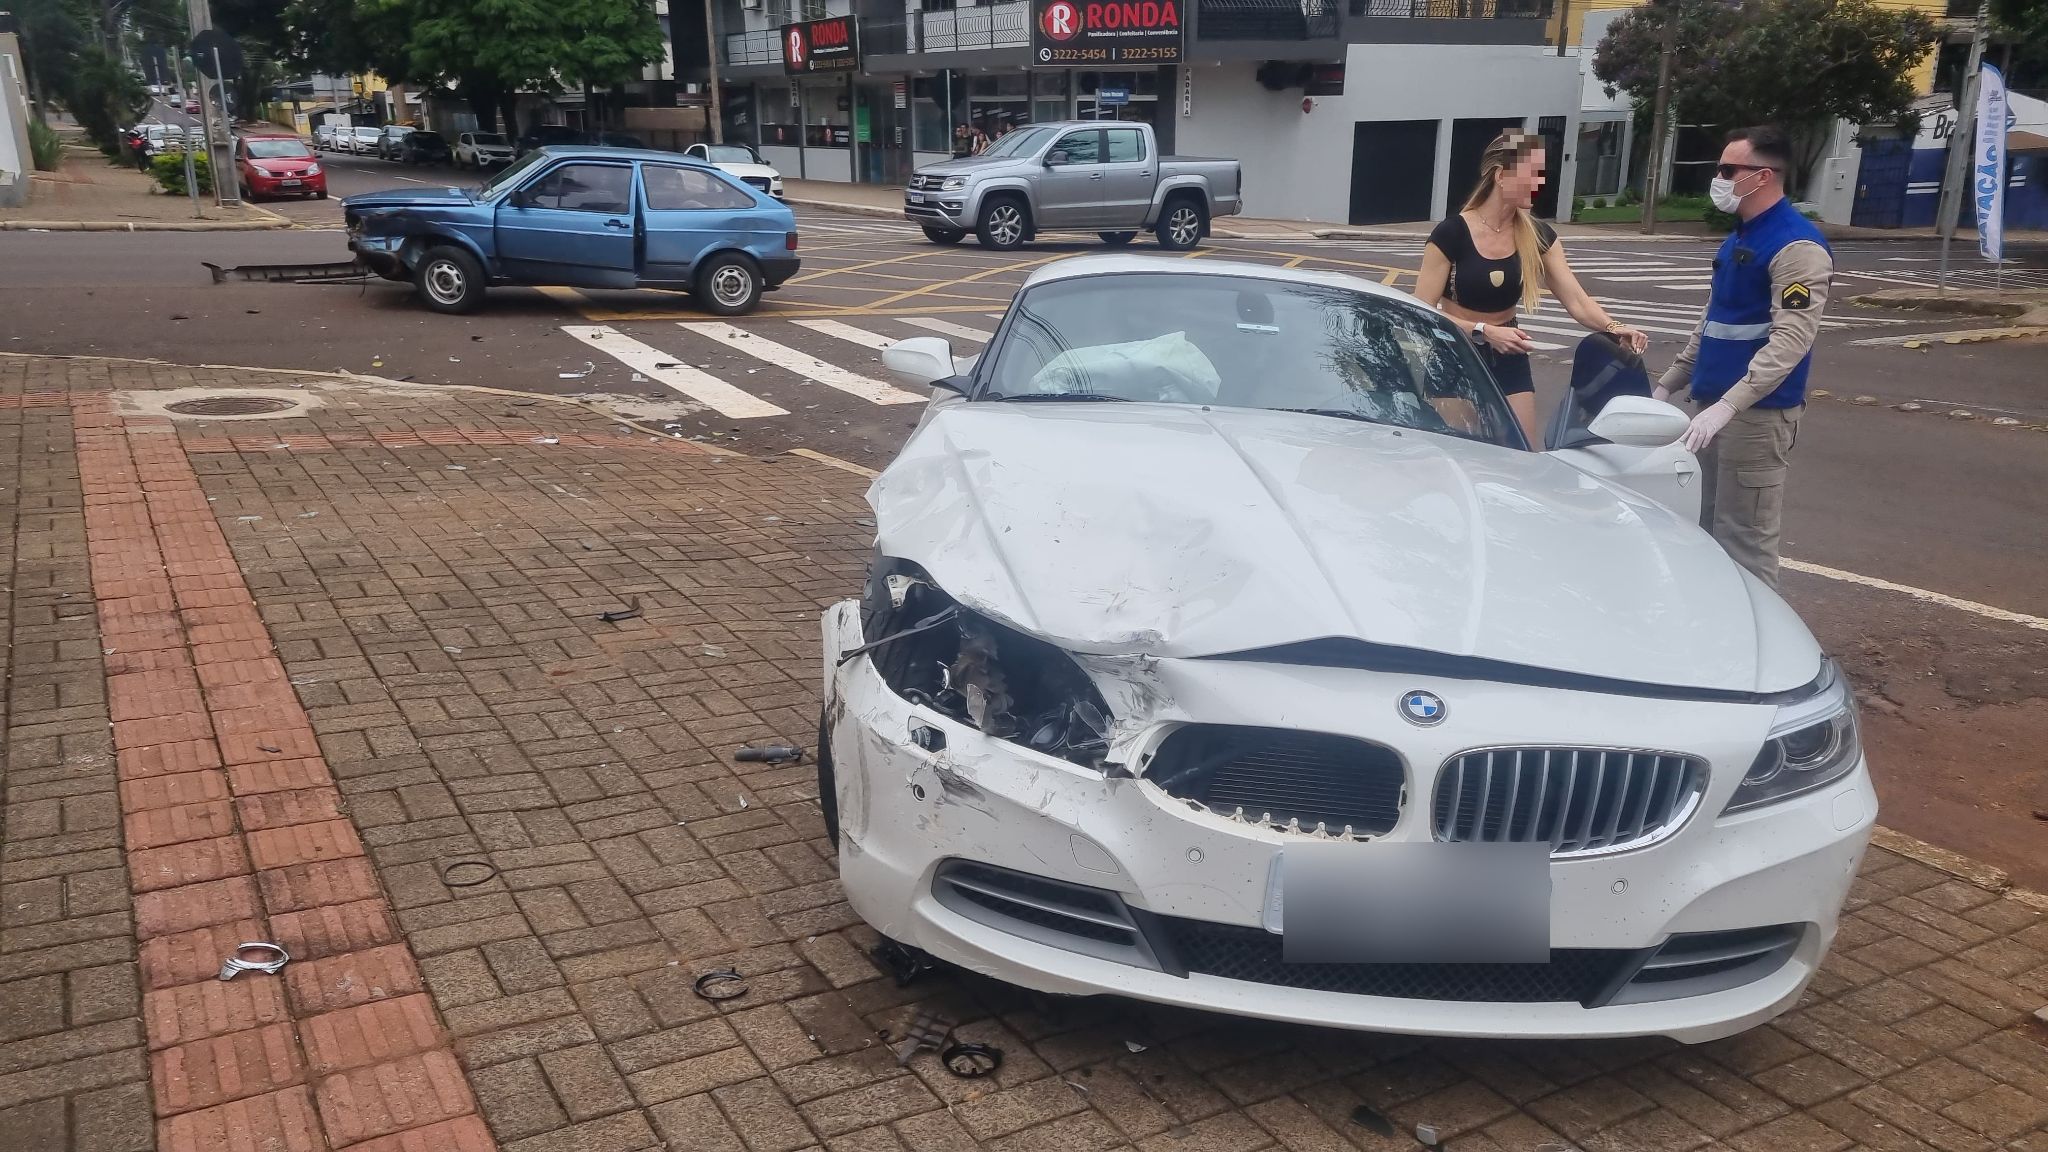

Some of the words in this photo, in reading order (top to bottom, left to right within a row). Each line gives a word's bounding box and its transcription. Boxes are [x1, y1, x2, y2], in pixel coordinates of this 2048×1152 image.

[1053, 5, 1072, 34] R
[1087, 2, 1178, 28] RONDA
[811, 19, 849, 46] RONDA
[791, 31, 802, 62] R
[1053, 49, 1107, 60] 3222-5454
[1121, 48, 1178, 59] 3222-5155
